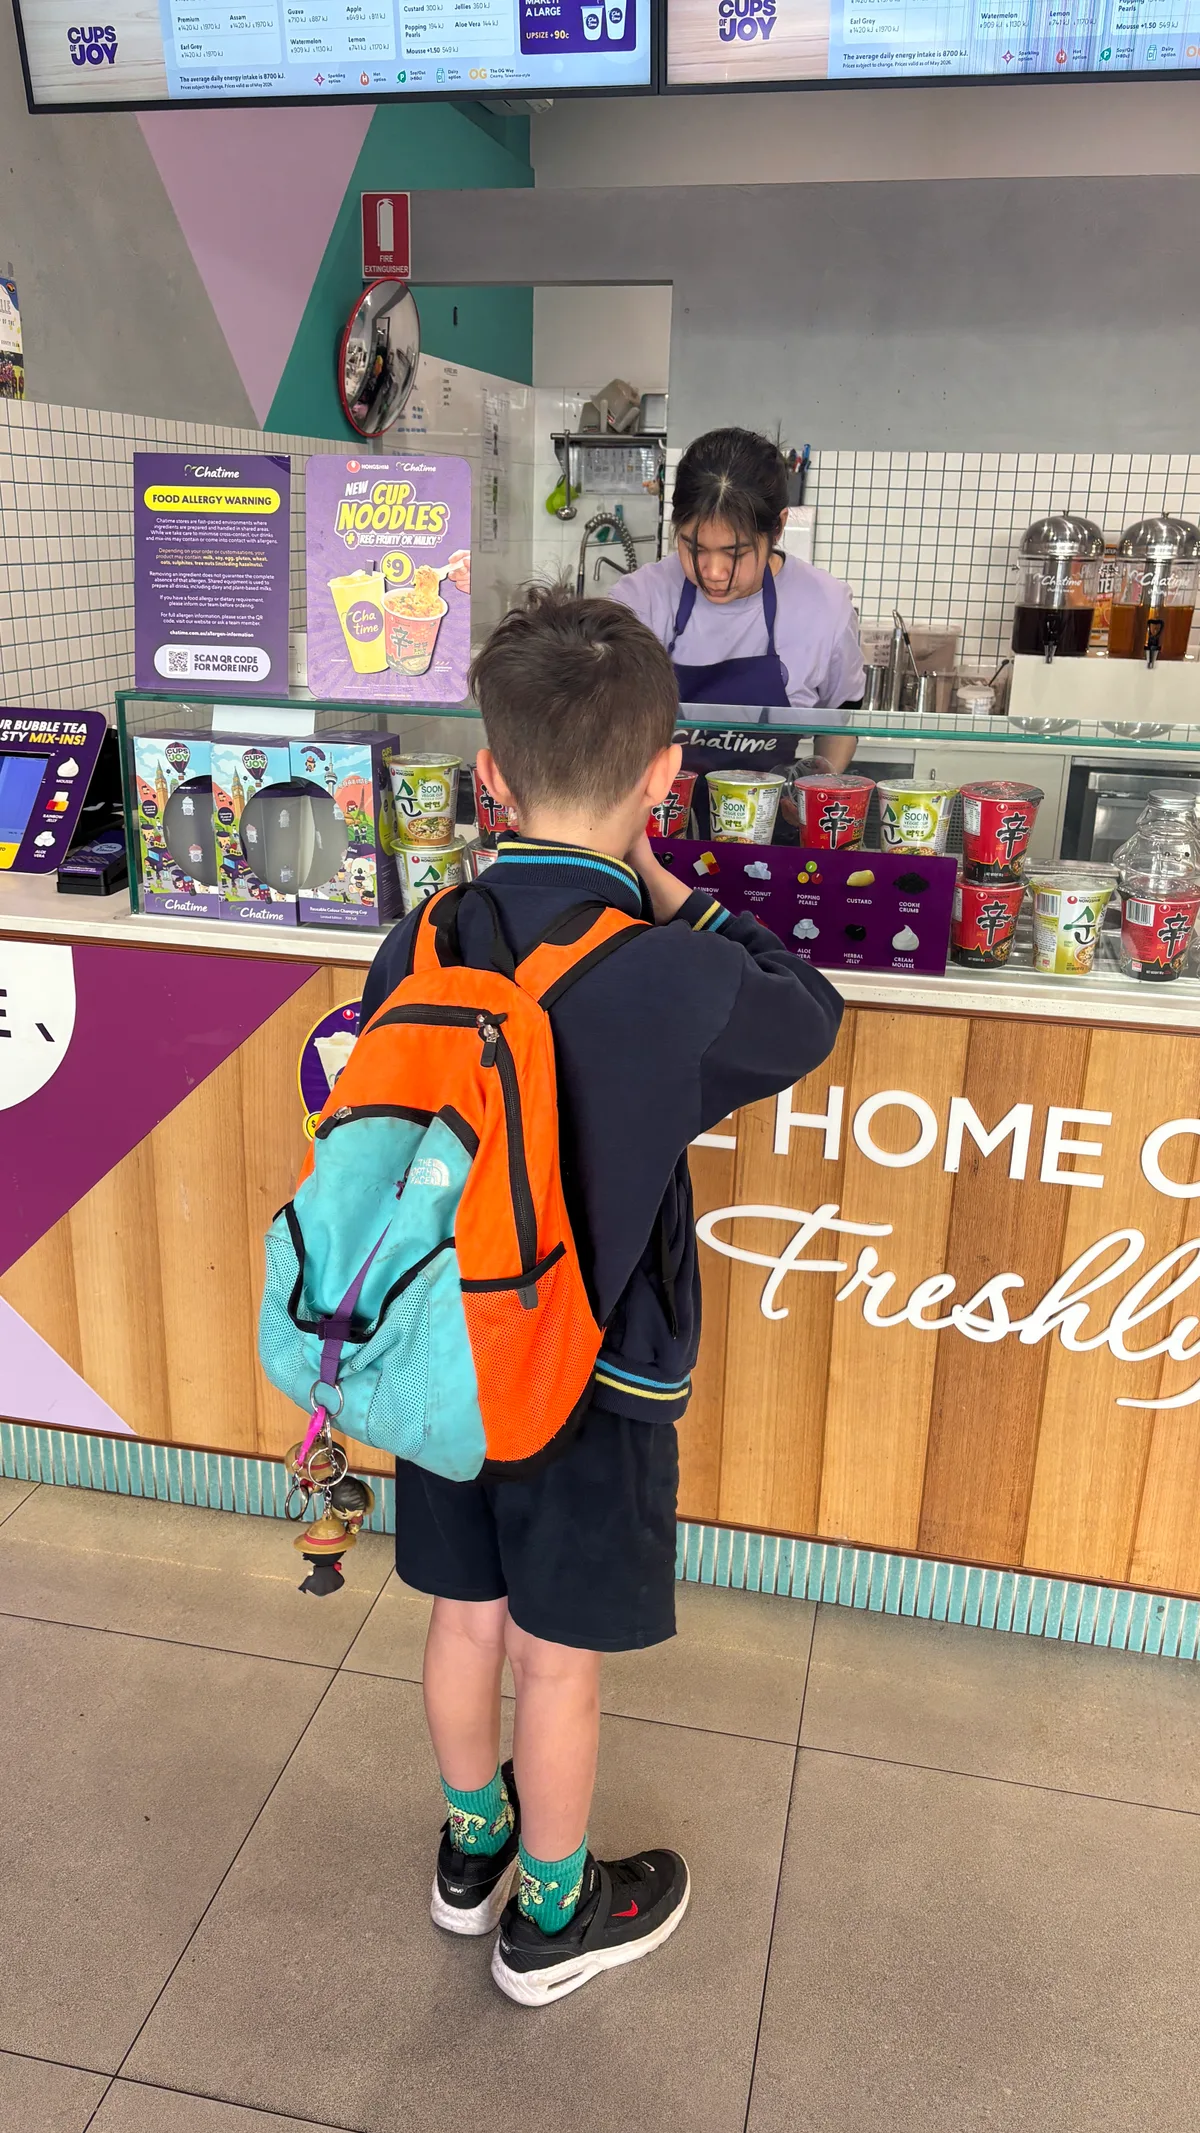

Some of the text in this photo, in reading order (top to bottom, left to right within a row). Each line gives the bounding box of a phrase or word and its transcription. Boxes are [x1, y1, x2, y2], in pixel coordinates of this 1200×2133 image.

[346, 6, 362, 14] Apple
[526, 6, 561, 17] A LARGE
[719, 0, 776, 18] CUPS
[1118, 4, 1136, 12] Pearls
[720, 18, 727, 26] OF
[981, 12, 1018, 20] Watermelon
[405, 24, 426, 32] Popping
[720, 16, 777, 42] JOY
[1116, 22, 1140, 30] Mousse
[68, 26, 116, 44] CUPS
[71, 43, 118, 65] JOY
[880, 52, 894, 60] daily
[211, 75, 222, 83] daily
[469, 68, 487, 80] OG
[380, 255, 393, 263] FIRE
[365, 265, 409, 274] EXTINGUISHER
[194, 466, 240, 479] Chatime
[403, 463, 436, 472] Chatime
[345, 480, 369, 496] NEW
[152, 494, 272, 506] FOOD ALLERGY WARNING
[373, 484, 410, 506] CUP
[338, 503, 446, 532] NOODLES
[360, 535, 375, 544] REG
[376, 535, 400, 545] FRUITY
[401, 535, 412, 545] OR
[387, 558, 404, 577] $9
[1041, 576, 1082, 586] Chatime
[352, 609, 376, 622] Cha
[354, 622, 379, 635] time
[194, 654, 258, 664] SCAN QR CODE
[194, 663, 259, 673] FOR MORE INFO
[14, 720, 62, 732] BUBBLE
[63, 722, 87, 734] TEA
[29, 732, 86, 745] MIX-INS!
[672, 730, 778, 753] Chatime
[246, 760, 266, 768] JOY
[421, 785, 442, 793] SOON
[723, 803, 745, 812] SOON
[904, 812, 929, 822] SOON
[818, 801, 855, 849] 辛
[996, 812, 1030, 859] 辛
[164, 899, 208, 913] Chatime
[240, 908, 284, 921] Chatime
[976, 900, 1012, 946] 辛
[1063, 906, 1096, 944] 순
[1157, 912, 1191, 958] 辛
[774, 1084, 1112, 1188] HOME
[410, 1176, 431, 1184] FACE
